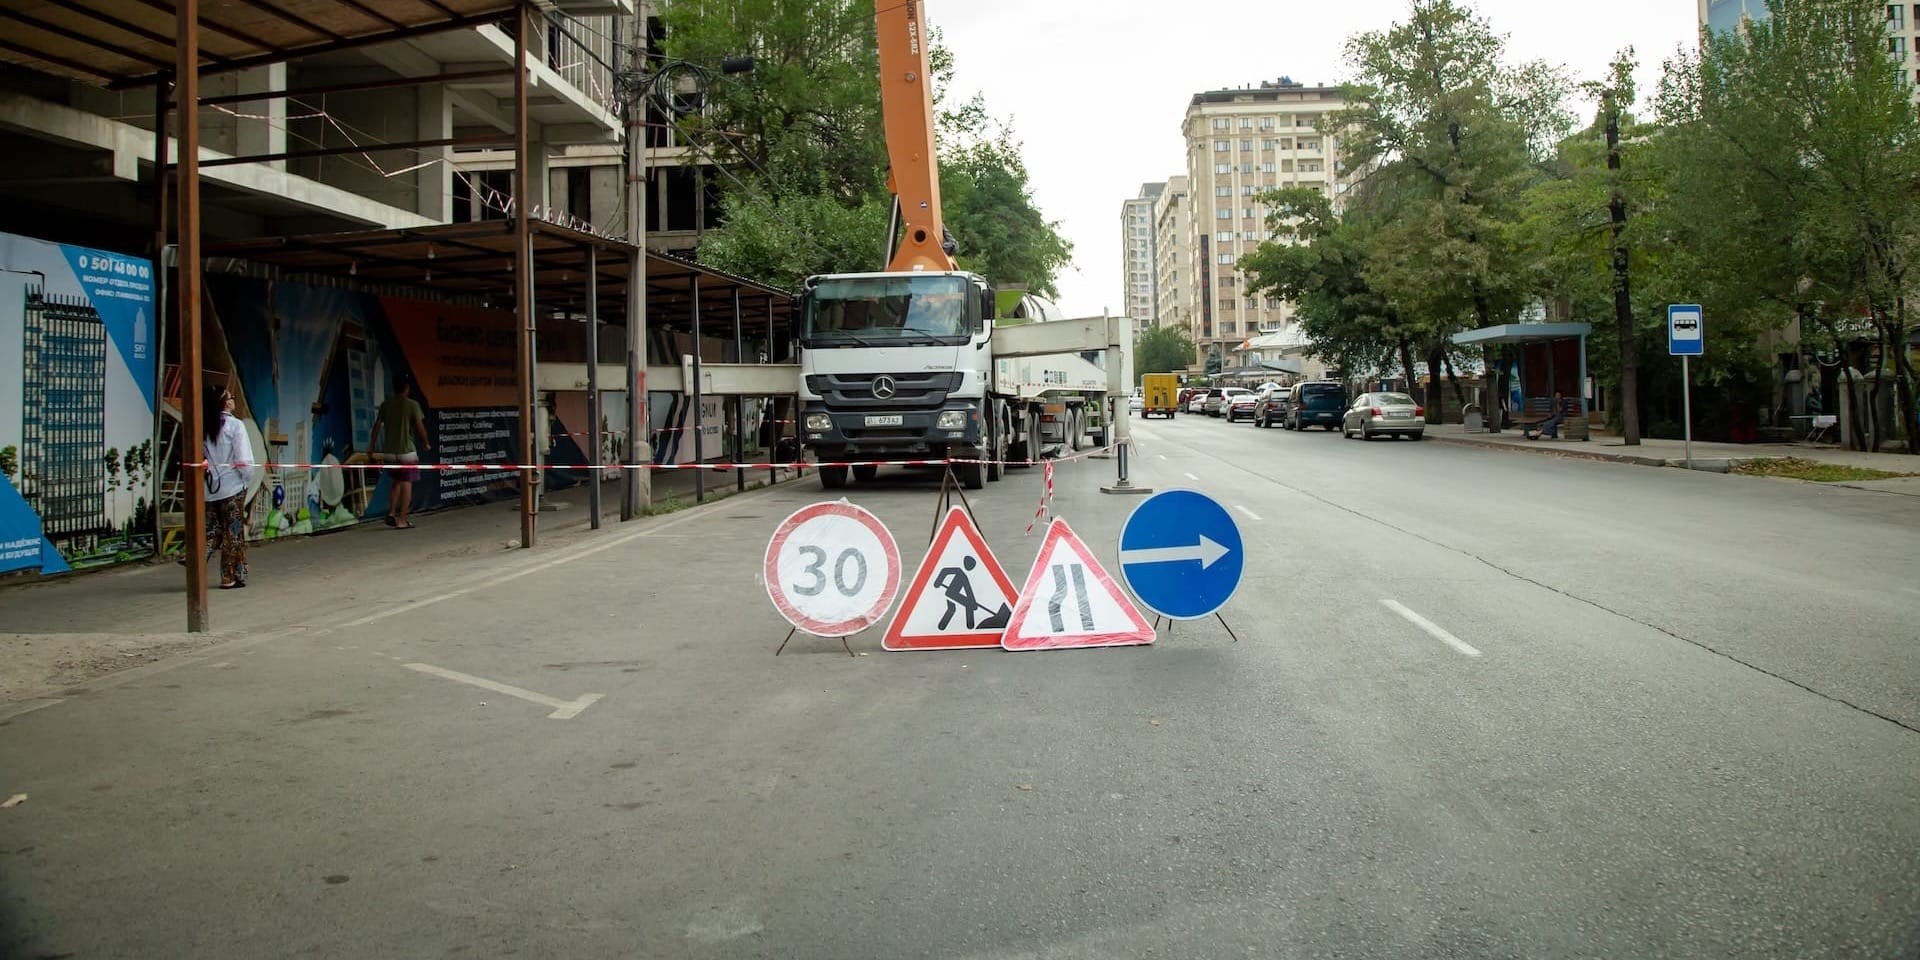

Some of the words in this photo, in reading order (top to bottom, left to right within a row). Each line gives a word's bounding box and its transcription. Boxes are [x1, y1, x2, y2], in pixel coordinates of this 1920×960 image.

[79, 255, 88, 268] 0
[126, 264, 138, 277] 00
[138, 266, 149, 279] 00
[792, 545, 867, 598] 30
